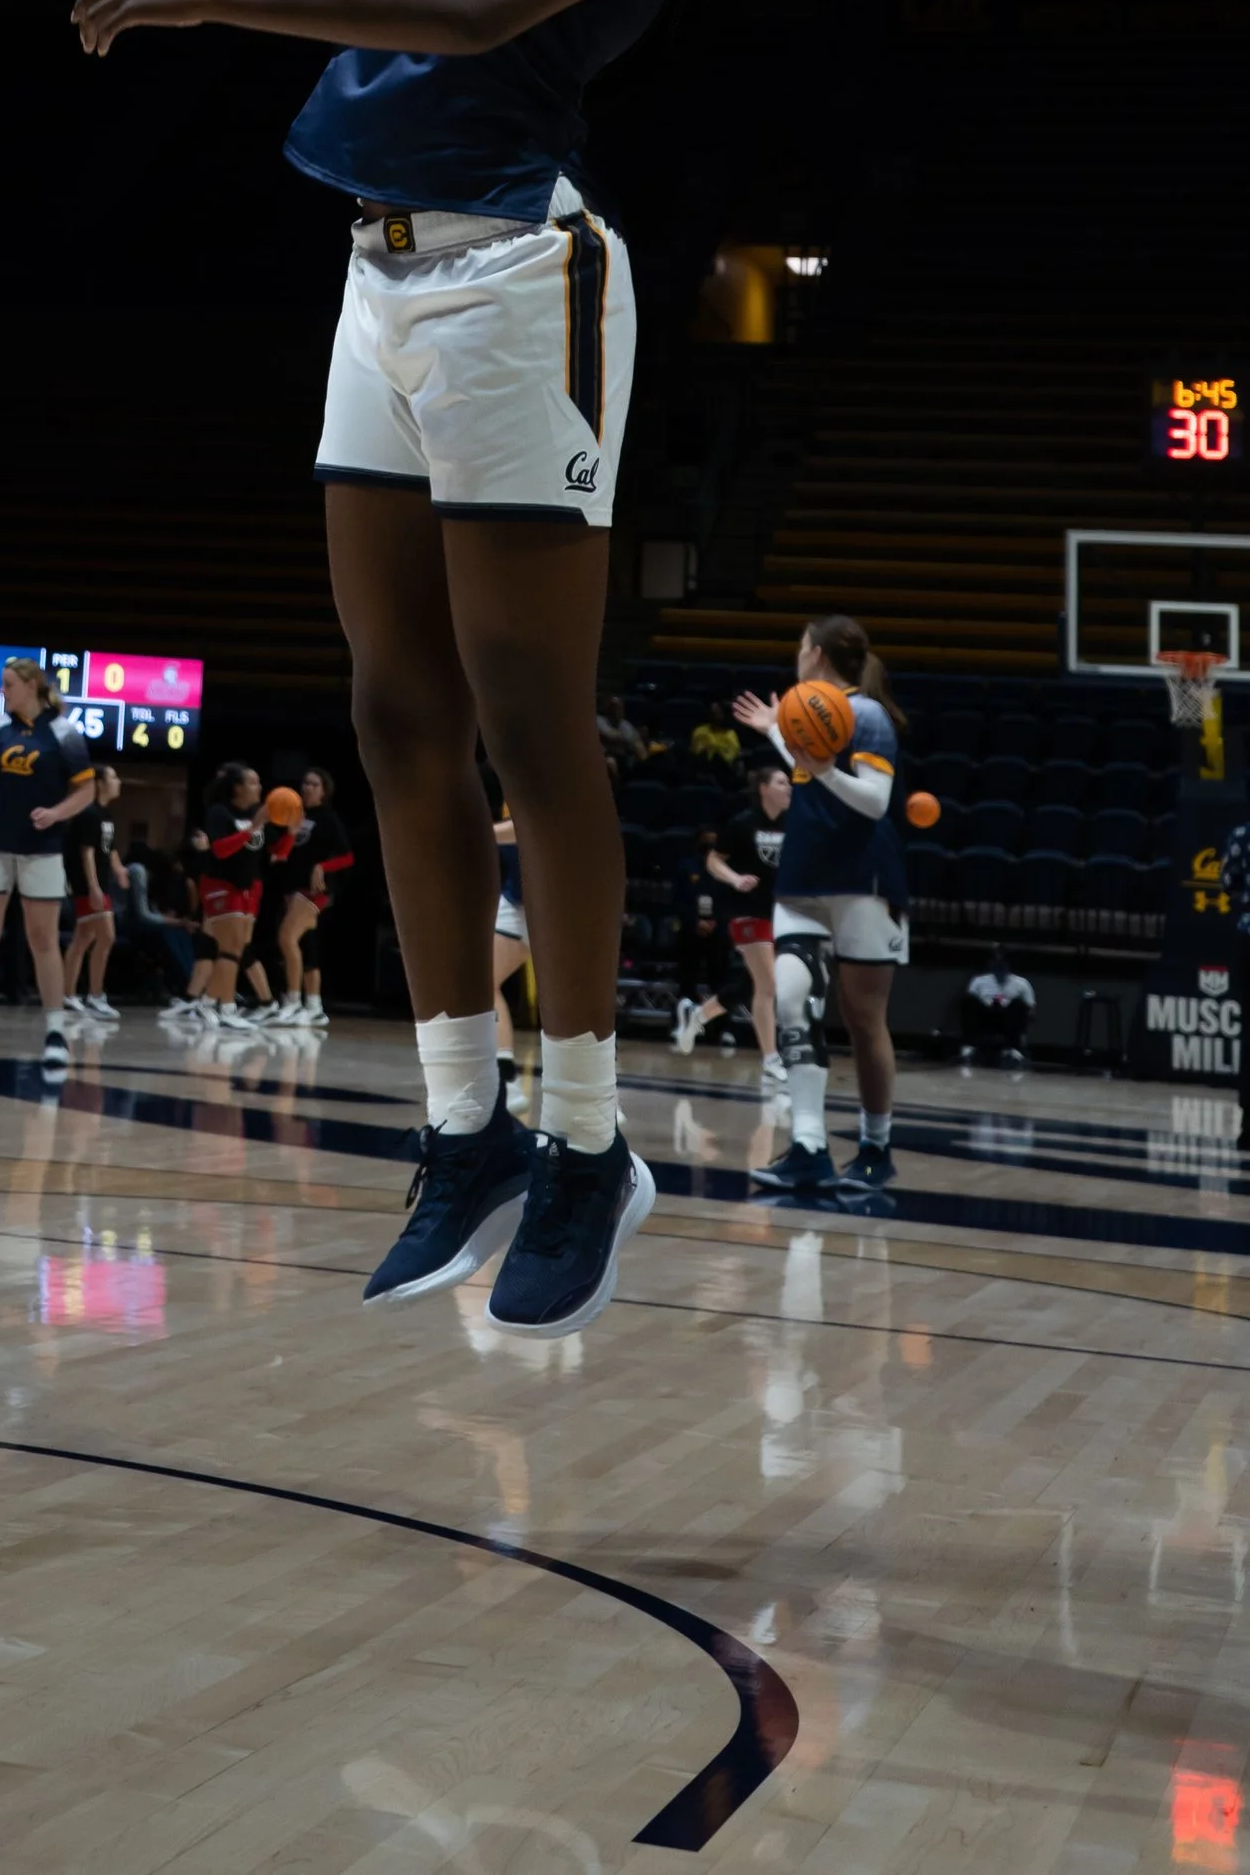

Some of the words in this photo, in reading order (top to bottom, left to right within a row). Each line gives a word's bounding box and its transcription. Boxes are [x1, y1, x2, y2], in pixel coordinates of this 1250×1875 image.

[1171, 378, 1238, 410] 6:45
[1167, 409, 1229, 460] 30
[564, 450, 600, 494] Cal
[56, 668, 71, 694] 1
[104, 663, 125, 693] 0
[132, 723, 150, 748] 4
[167, 725, 185, 749] 0
[0, 744, 40, 776] Cal
[1191, 847, 1224, 881] Ca
[1146, 994, 1243, 1038] MUSC
